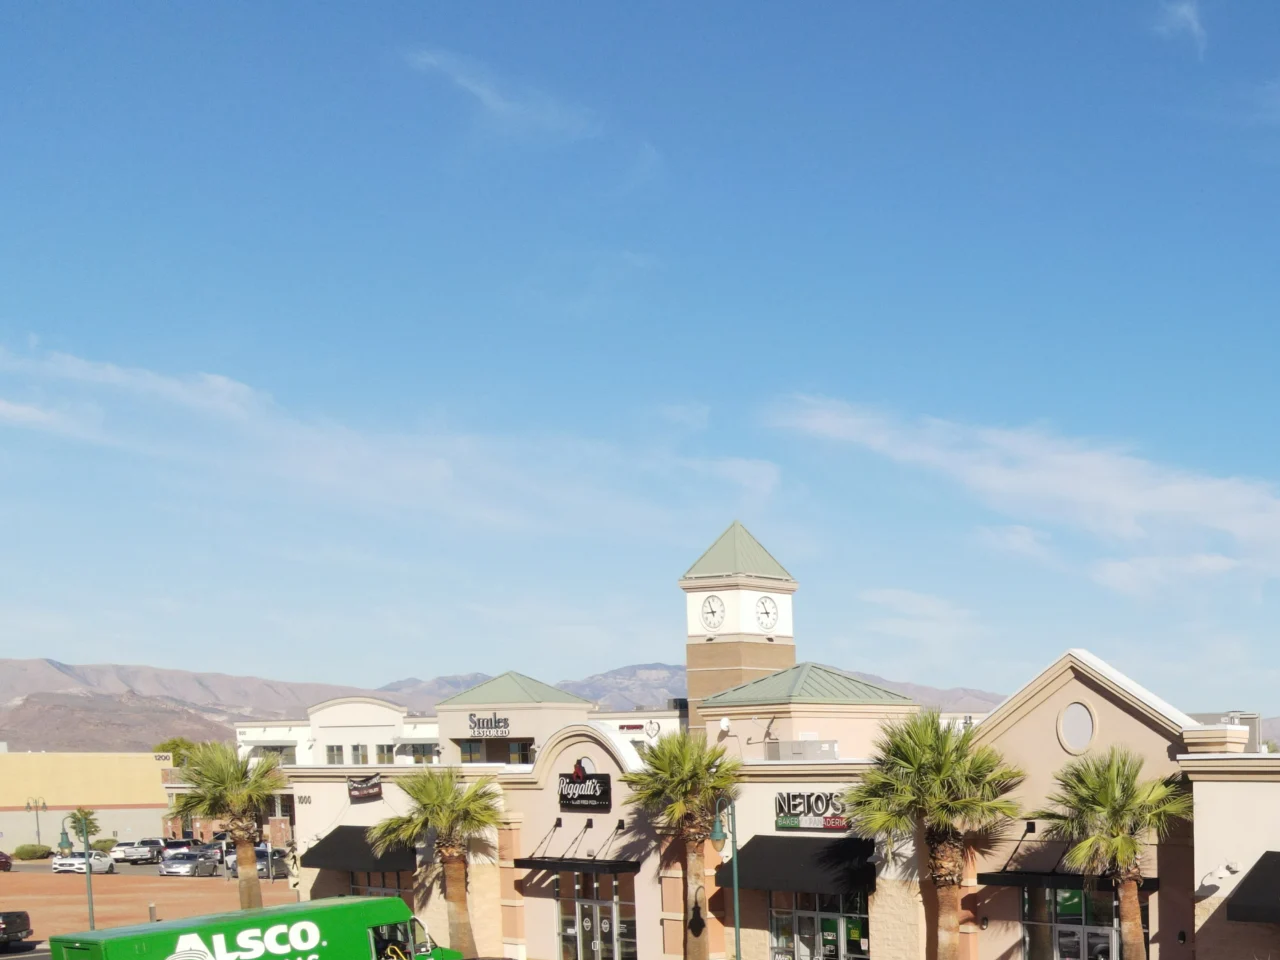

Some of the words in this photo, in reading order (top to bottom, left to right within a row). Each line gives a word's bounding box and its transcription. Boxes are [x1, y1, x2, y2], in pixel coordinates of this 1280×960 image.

[469, 712, 509, 729] Smiles
[469, 728, 510, 737] RESTORED
[558, 777, 602, 799] Riggatti's
[298, 796, 312, 805] 1000
[776, 792, 844, 814] NETO'S
